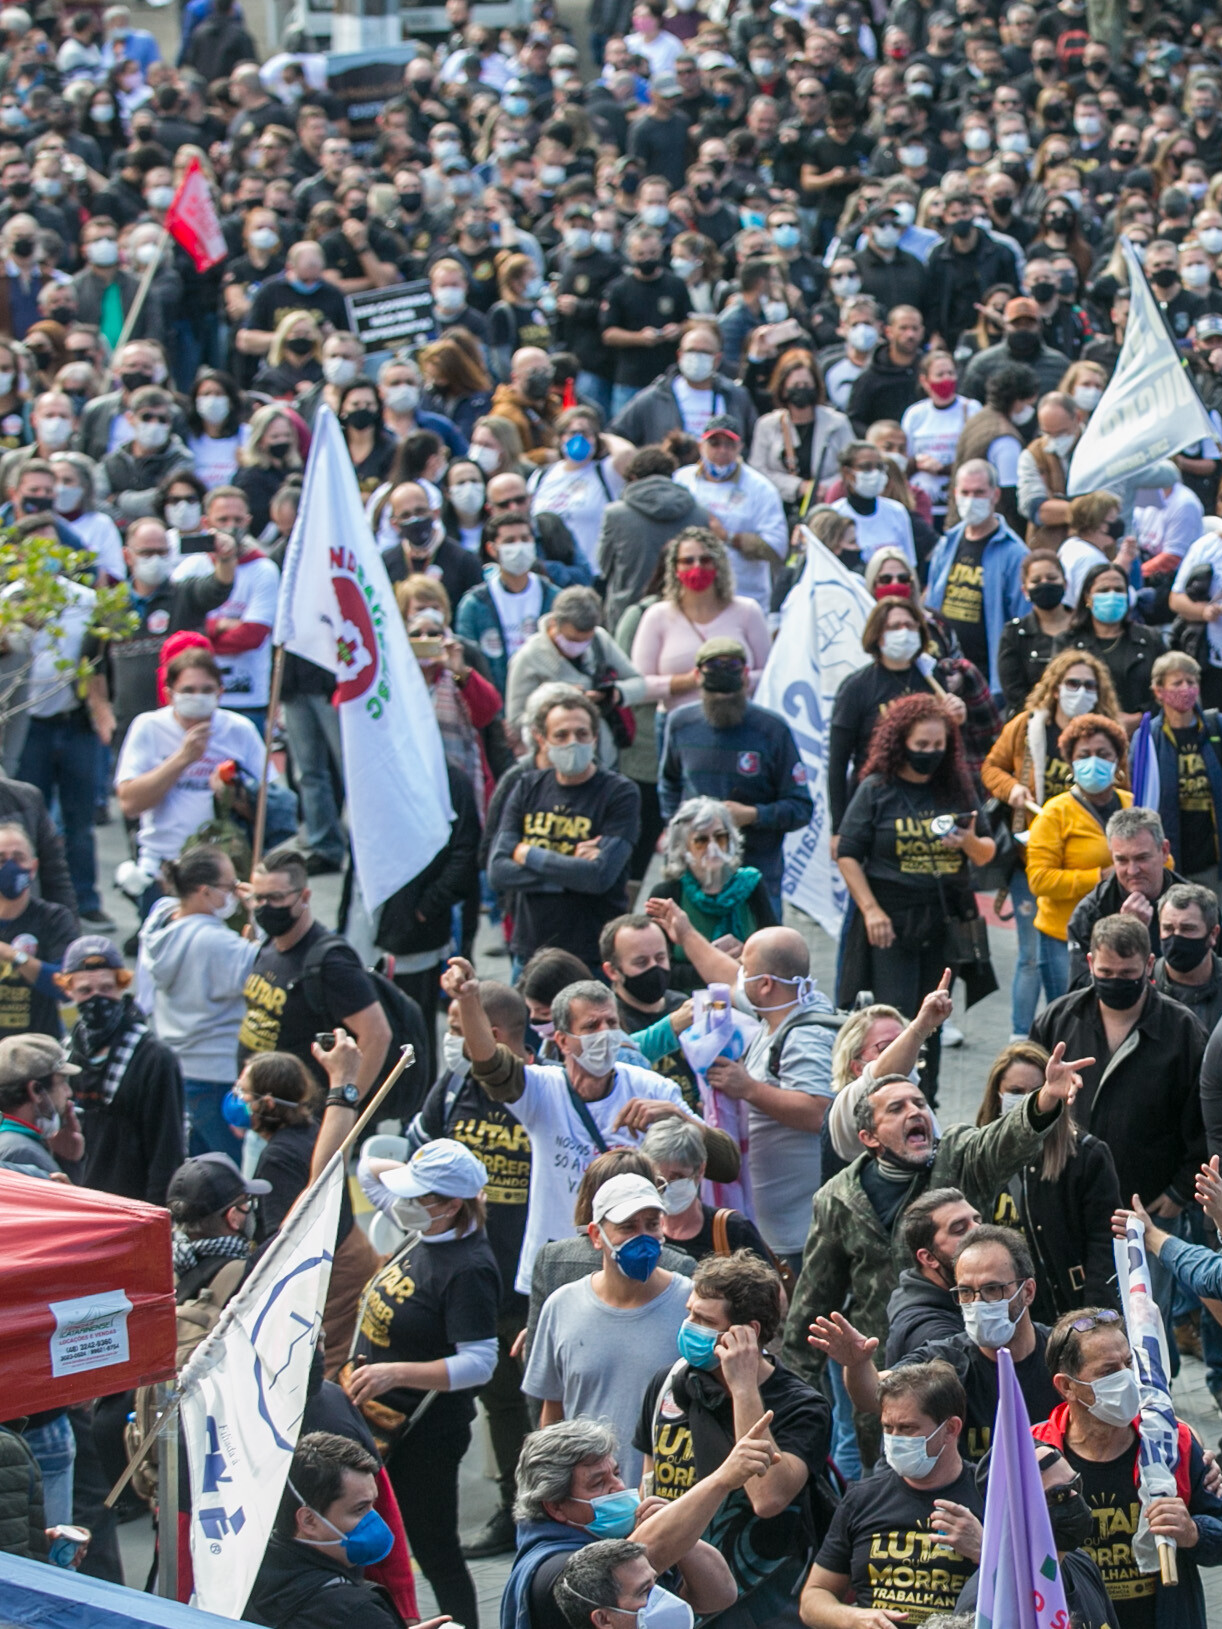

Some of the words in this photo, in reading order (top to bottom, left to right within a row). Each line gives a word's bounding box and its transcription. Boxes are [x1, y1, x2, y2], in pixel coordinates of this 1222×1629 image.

[523, 811, 592, 840] LUTAR
[869, 1530, 964, 1562] LUTA
[868, 1562, 970, 1593] MORRE
